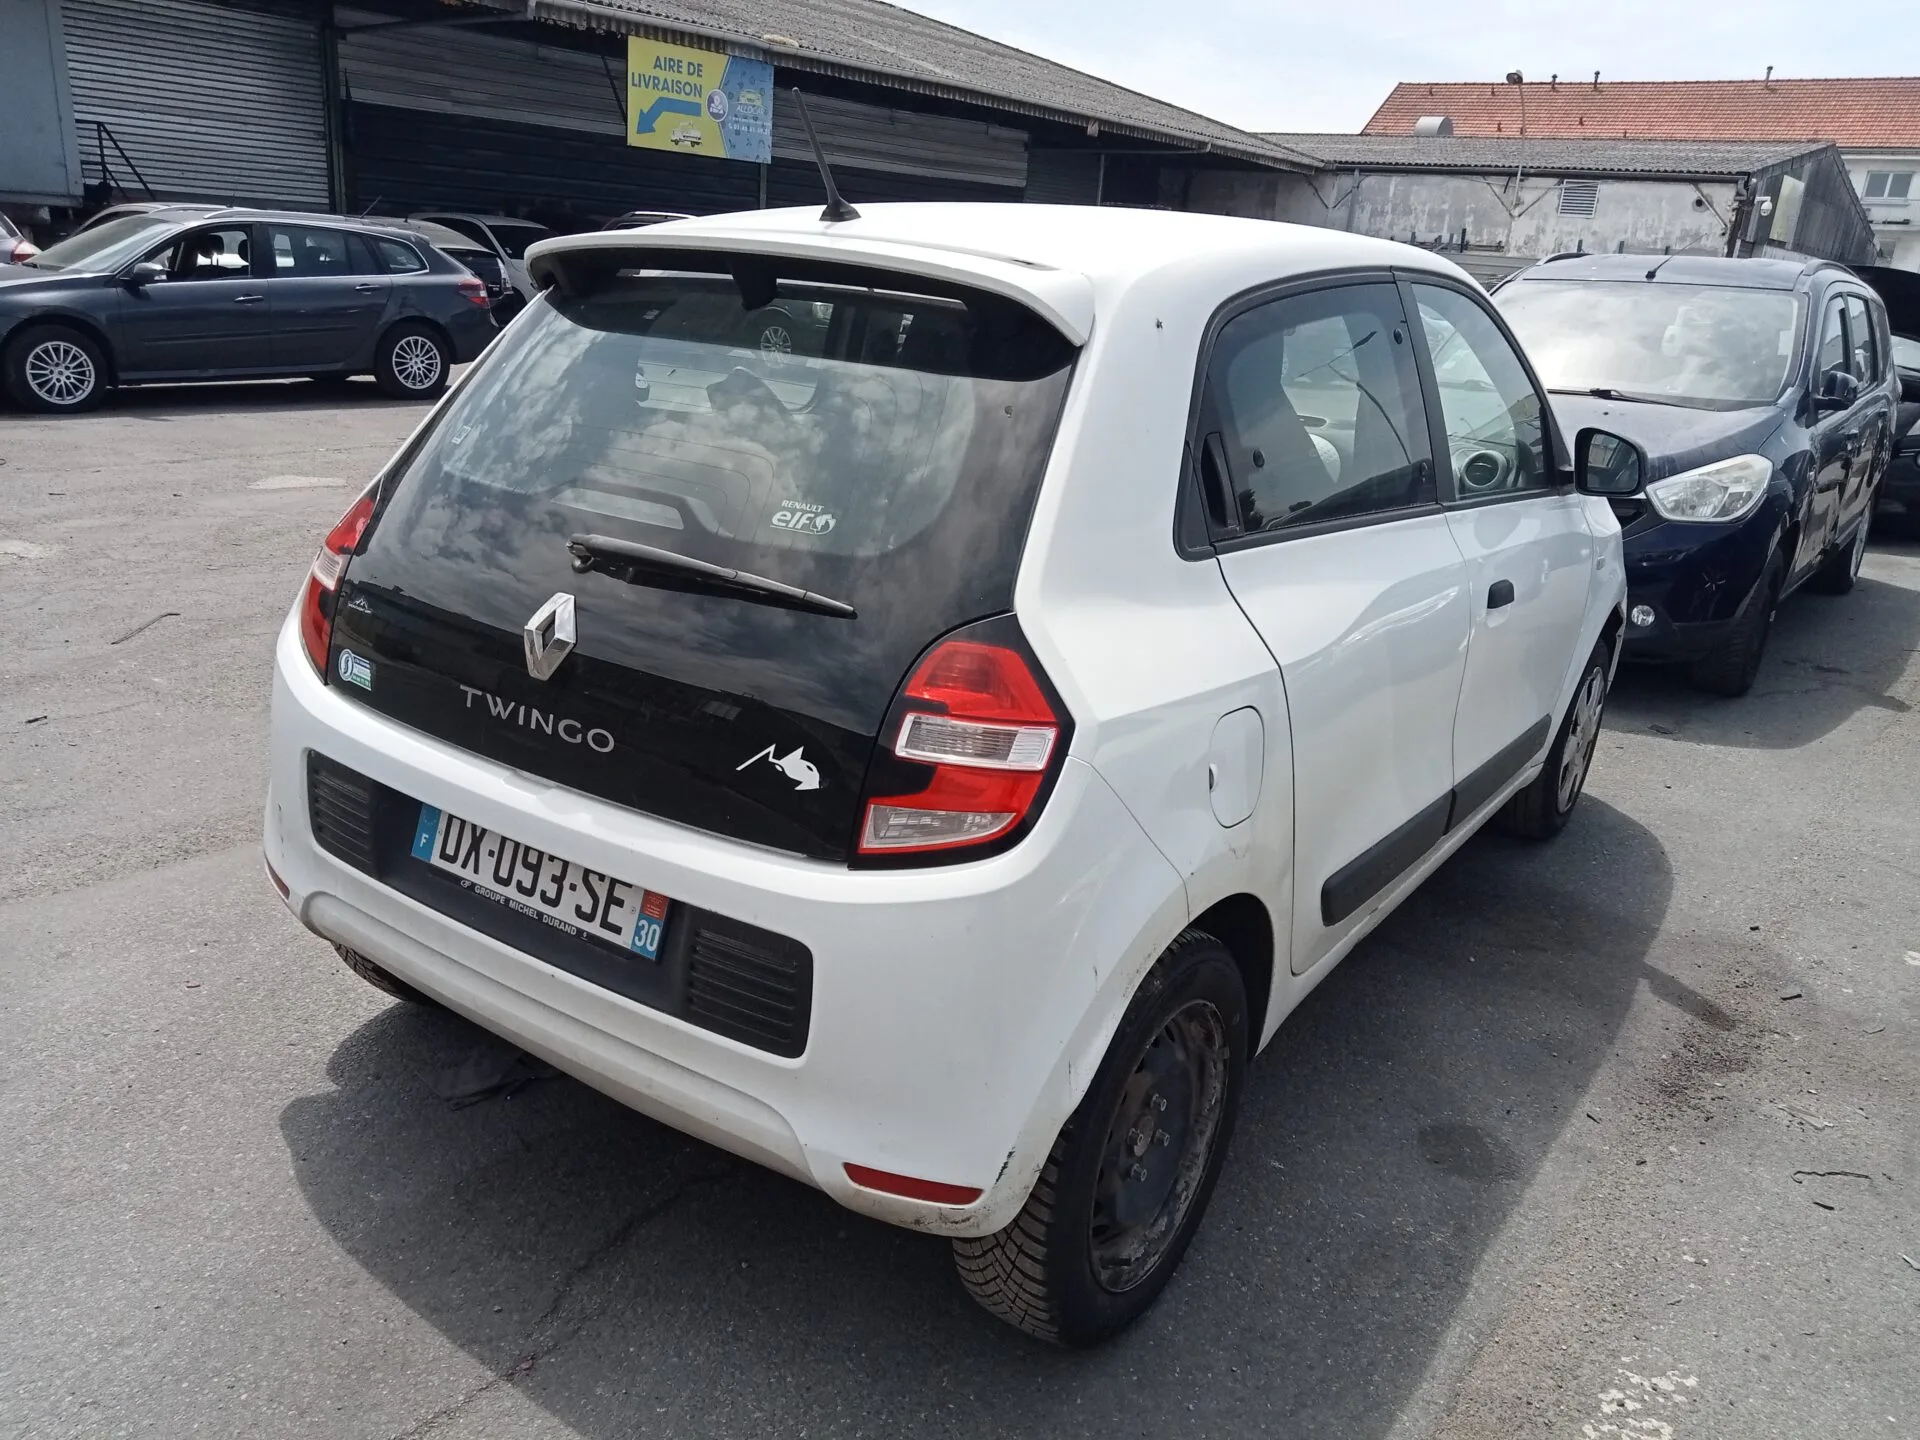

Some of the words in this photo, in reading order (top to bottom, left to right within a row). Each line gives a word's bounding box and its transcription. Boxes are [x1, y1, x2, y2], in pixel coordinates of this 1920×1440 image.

[653, 55, 683, 73] AIRE
[687, 61, 703, 78] DE
[631, 72, 703, 98] LIVRAISON
[781, 499, 824, 513] RENAULT
[771, 511, 815, 529] elf
[460, 684, 615, 753] TWINGO
[419, 833, 429, 847] F
[474, 885, 506, 905] GROUPE
[508, 899, 539, 920] MICHEL
[542, 914, 577, 936] DURAND
[635, 919, 660, 952] 30
